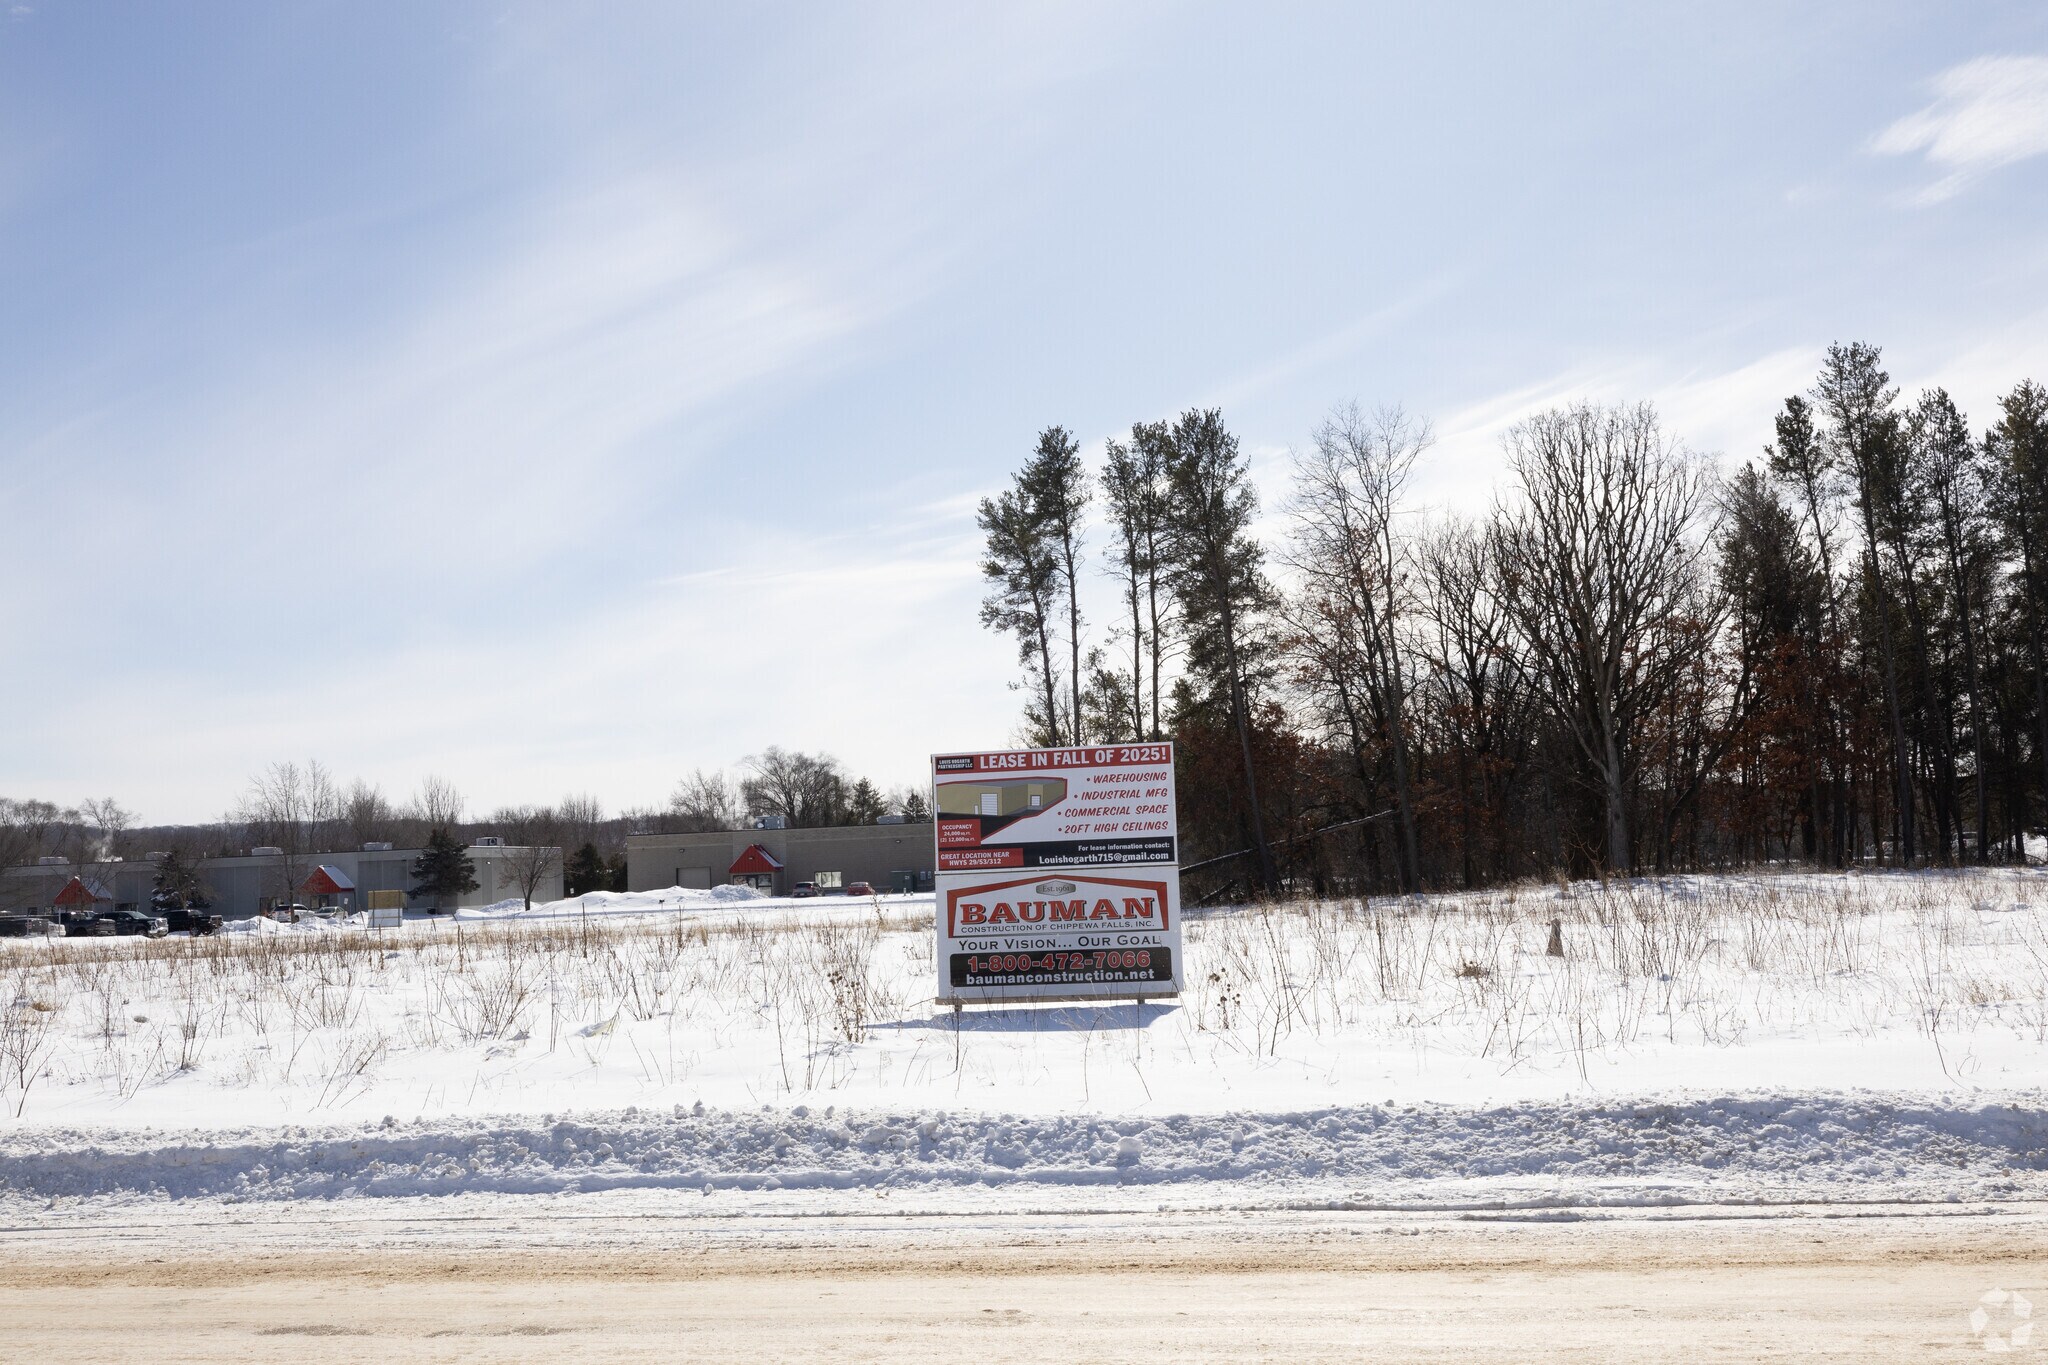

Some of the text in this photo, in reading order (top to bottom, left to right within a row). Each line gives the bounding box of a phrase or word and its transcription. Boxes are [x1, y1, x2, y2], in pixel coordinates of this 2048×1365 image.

[980, 747, 1166, 769] LEASE IN FALL OF 2025!
[1094, 772, 1167, 783] WAREHOUSING
[1081, 788, 1168, 800] INDUSTRIAL MFG
[1065, 805, 1168, 817] COMMERCIAL SPACE
[1065, 821, 1168, 834] 20FT HIGH CEILINGS
[1039, 852, 1168, 865] Louishogarth715@gmail.com
[960, 897, 1155, 925] BAUMAN
[961, 925, 1033, 933] CONSTRUCTION
[967, 951, 1151, 972] 1-800-472-7066
[966, 969, 1154, 985] baumanconstruction.net
